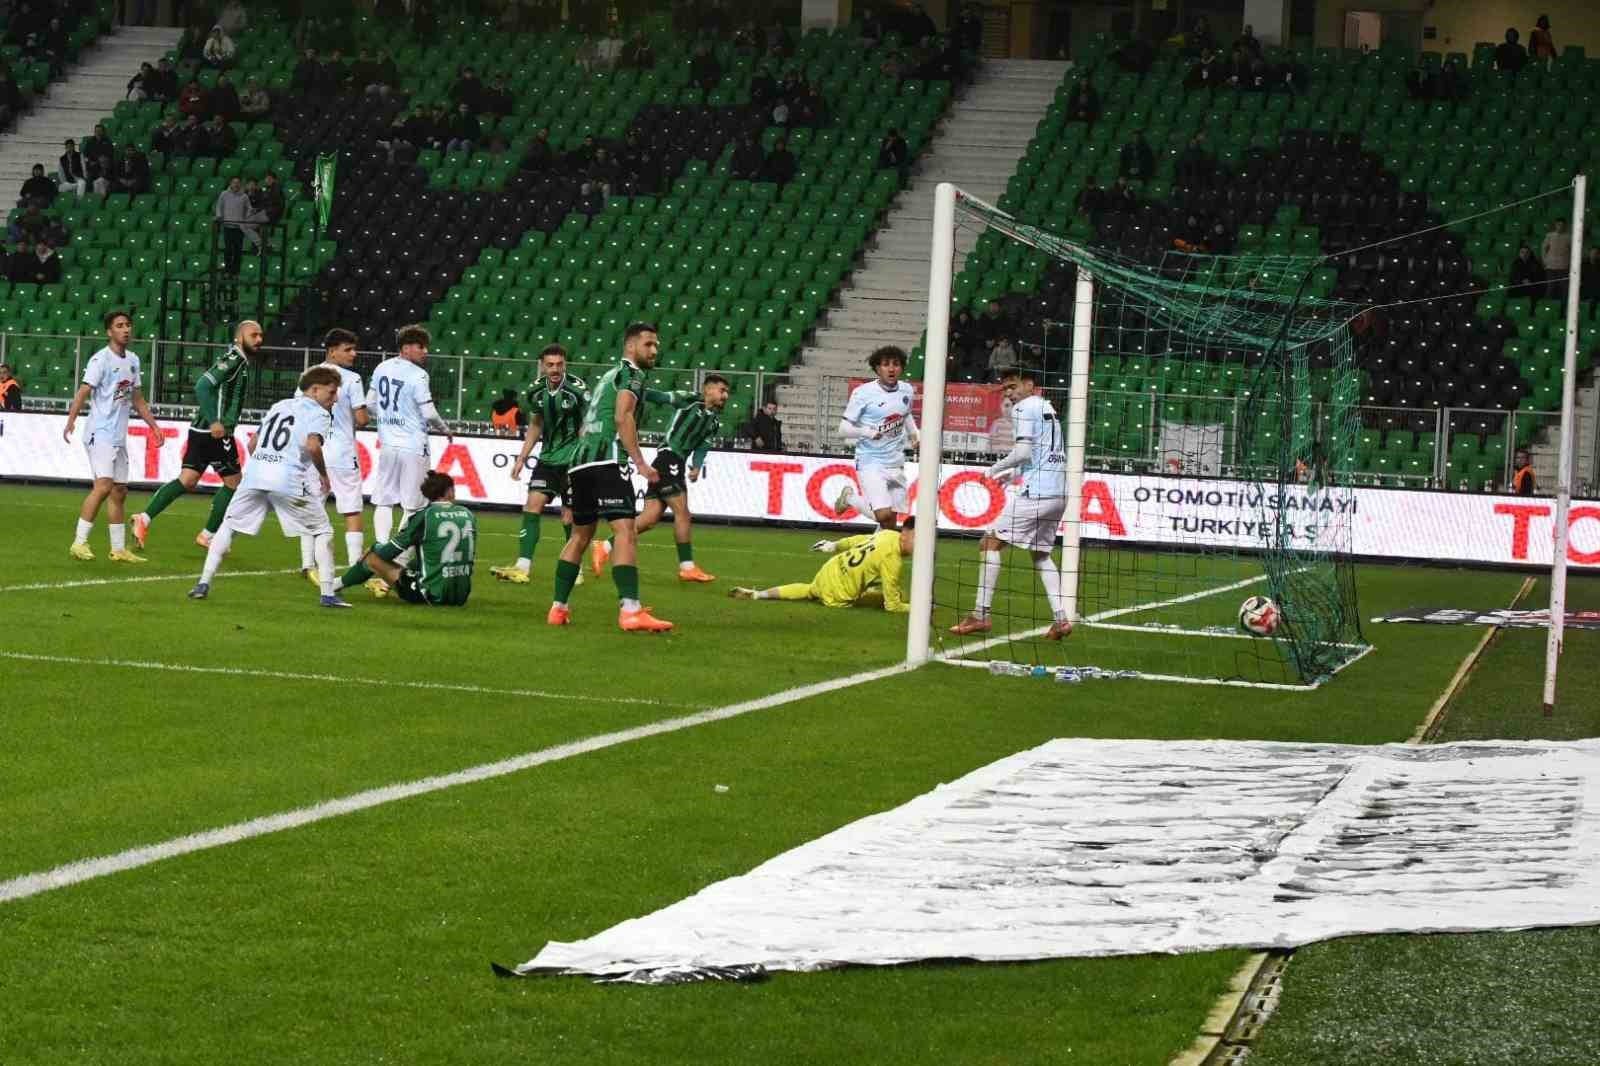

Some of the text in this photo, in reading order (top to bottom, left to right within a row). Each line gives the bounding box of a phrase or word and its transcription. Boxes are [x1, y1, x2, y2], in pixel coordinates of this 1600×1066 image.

[378, 375, 405, 412] 97
[260, 411, 295, 452] 16
[750, 461, 1128, 536] TOOA
[1133, 486, 1358, 515] OTOMOTİV SANAYİ
[437, 519, 474, 563] 21
